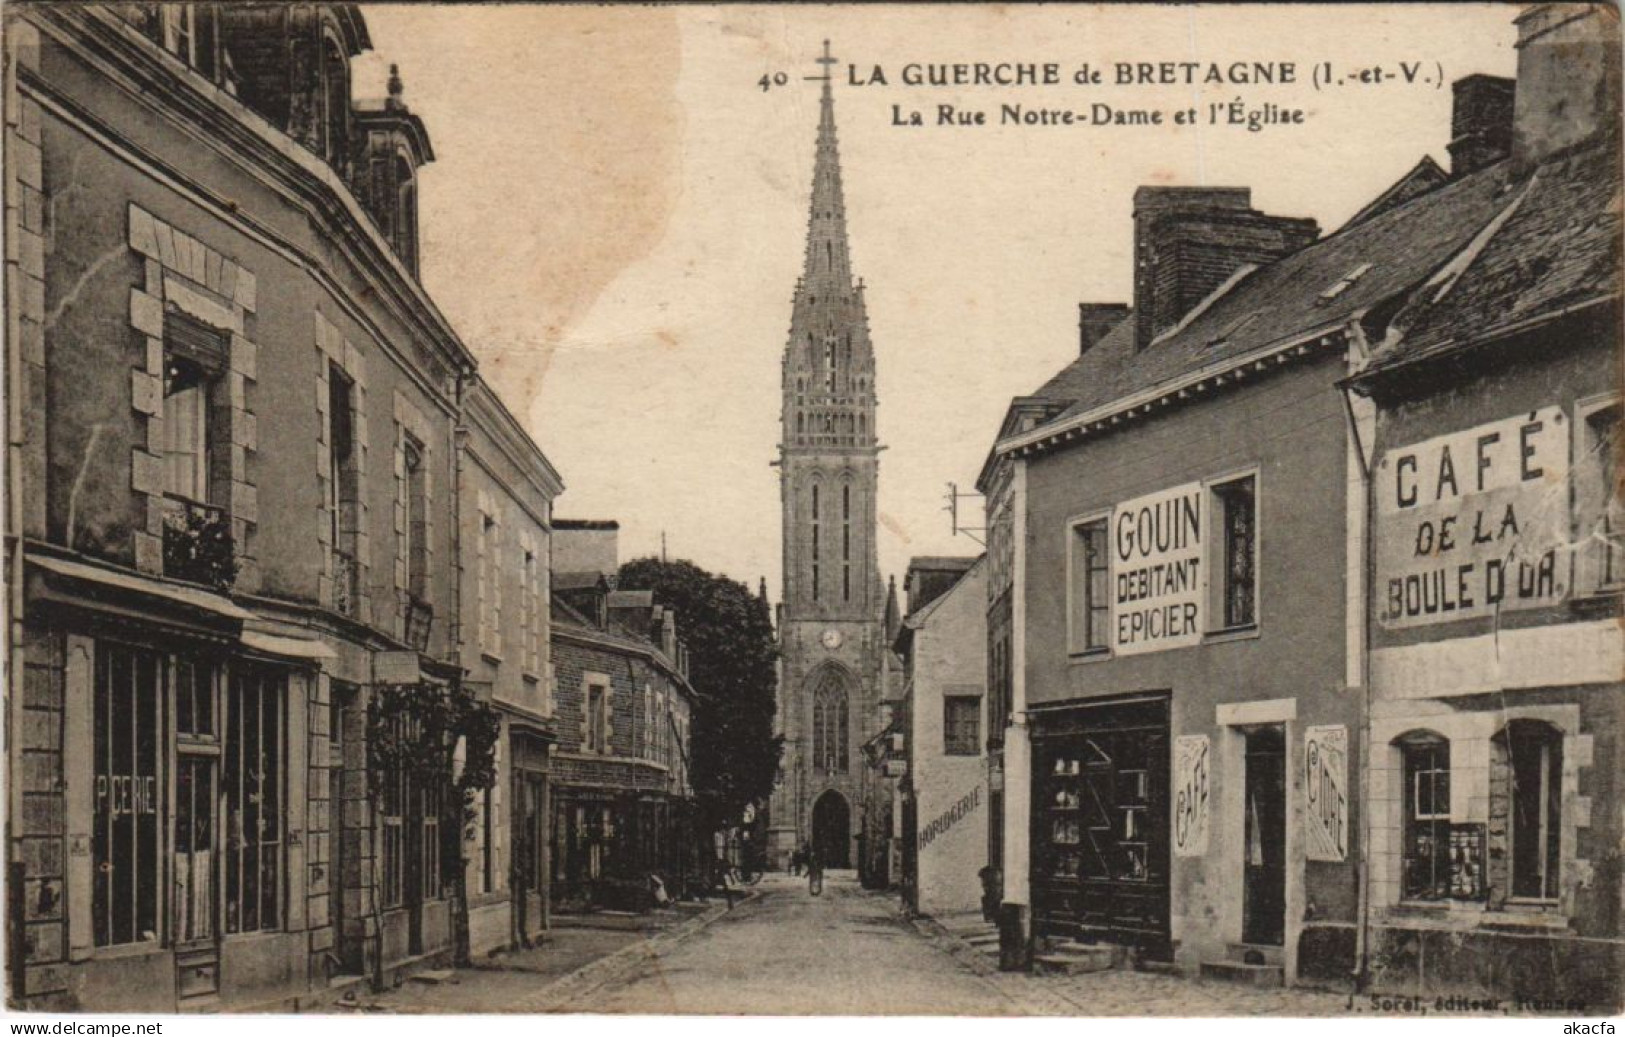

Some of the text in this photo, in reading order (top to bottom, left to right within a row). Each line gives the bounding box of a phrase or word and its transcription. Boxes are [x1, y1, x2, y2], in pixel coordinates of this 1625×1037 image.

[1397, 411, 1543, 508] CAFÉ
[1117, 492, 1200, 561] GOUIN
[1414, 504, 1519, 556] DE LA
[1118, 557, 1199, 604] DEBITANT
[1388, 564, 1474, 619] BOULE
[1118, 602, 1197, 644] EPICIER
